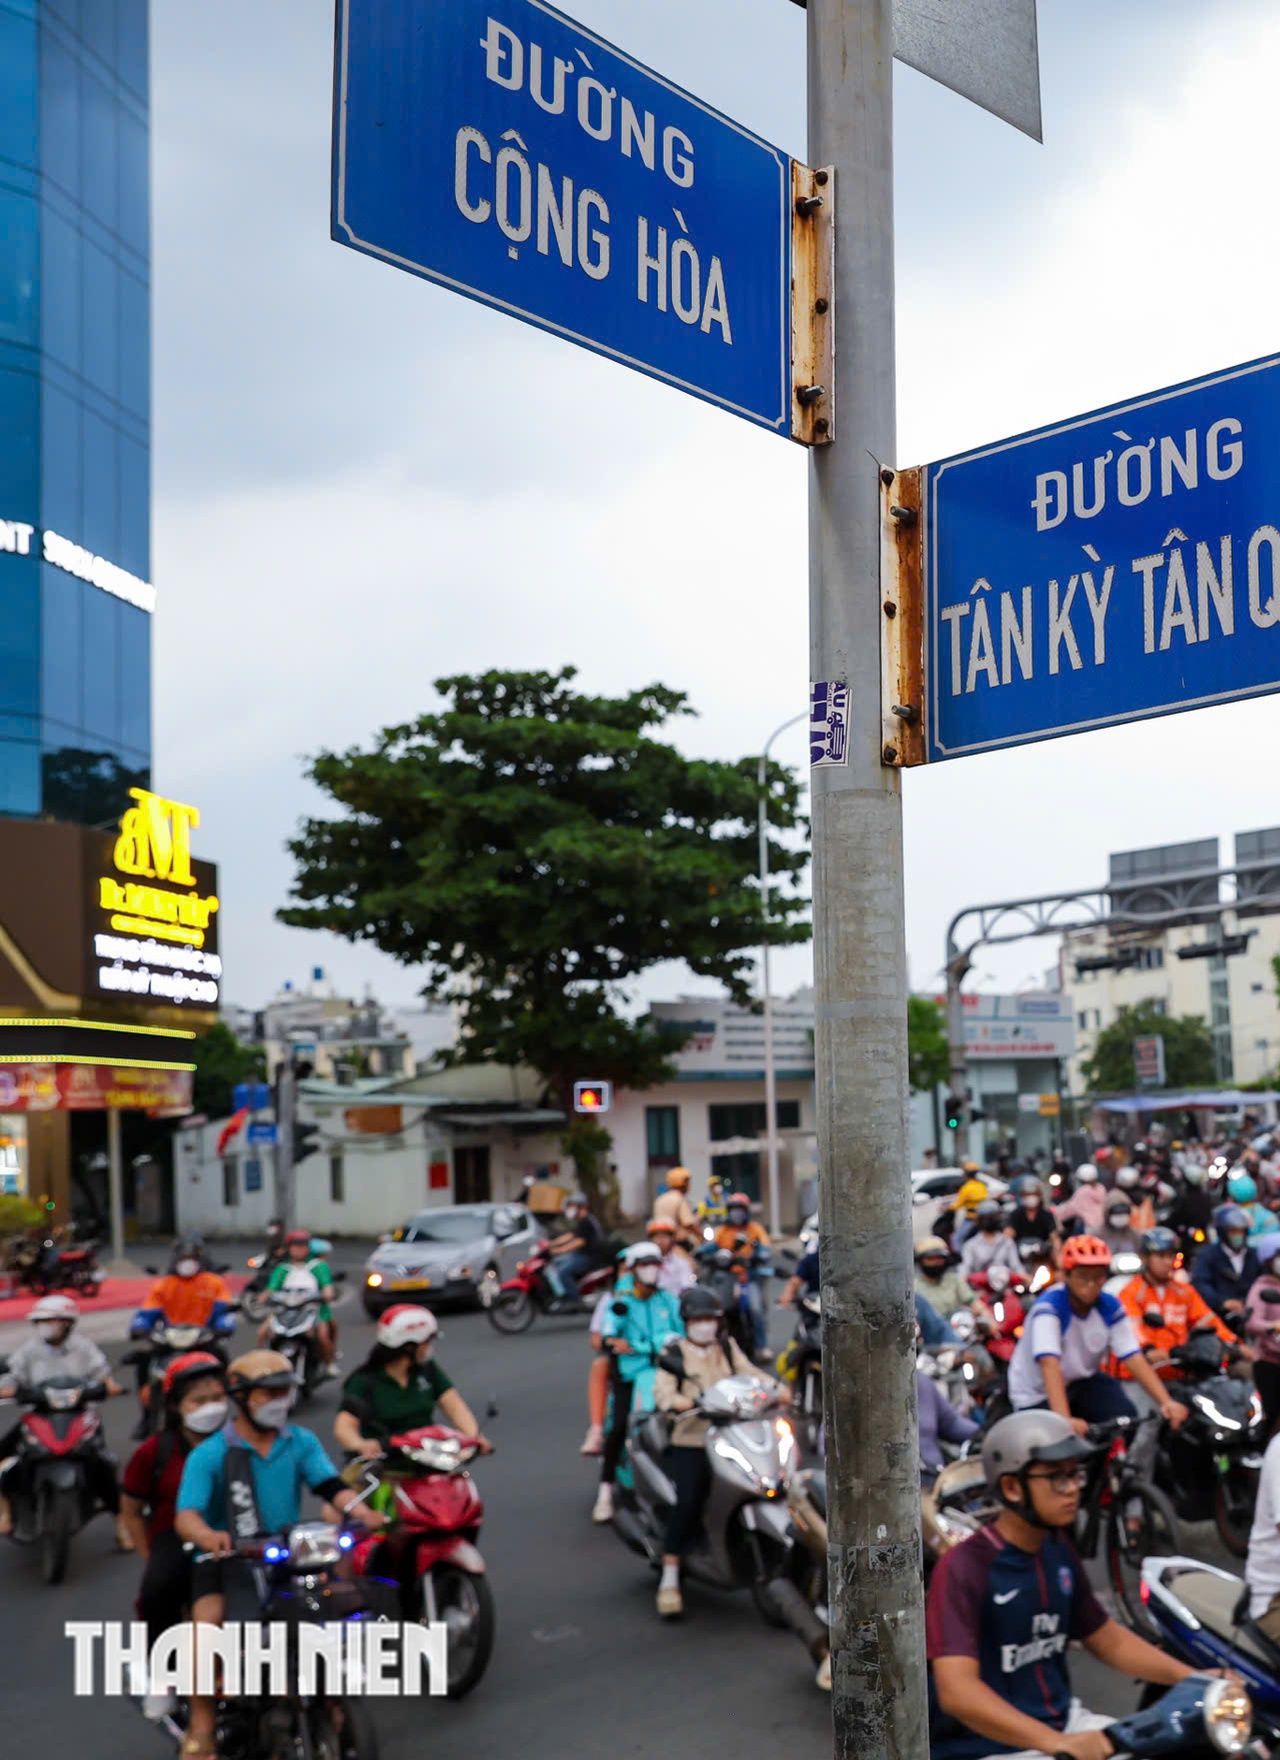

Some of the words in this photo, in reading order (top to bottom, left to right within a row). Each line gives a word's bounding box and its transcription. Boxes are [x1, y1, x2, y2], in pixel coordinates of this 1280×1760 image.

[480, 16, 696, 188] ĐƯỜNG
[454, 125, 611, 281] CỘNG
[637, 208, 733, 346] HÒA
[1030, 416, 1244, 533] ĐƯỜNG
[941, 577, 1034, 697] TÂN
[1047, 543, 1116, 676] KỲ
[1131, 527, 1236, 655] TÂN
